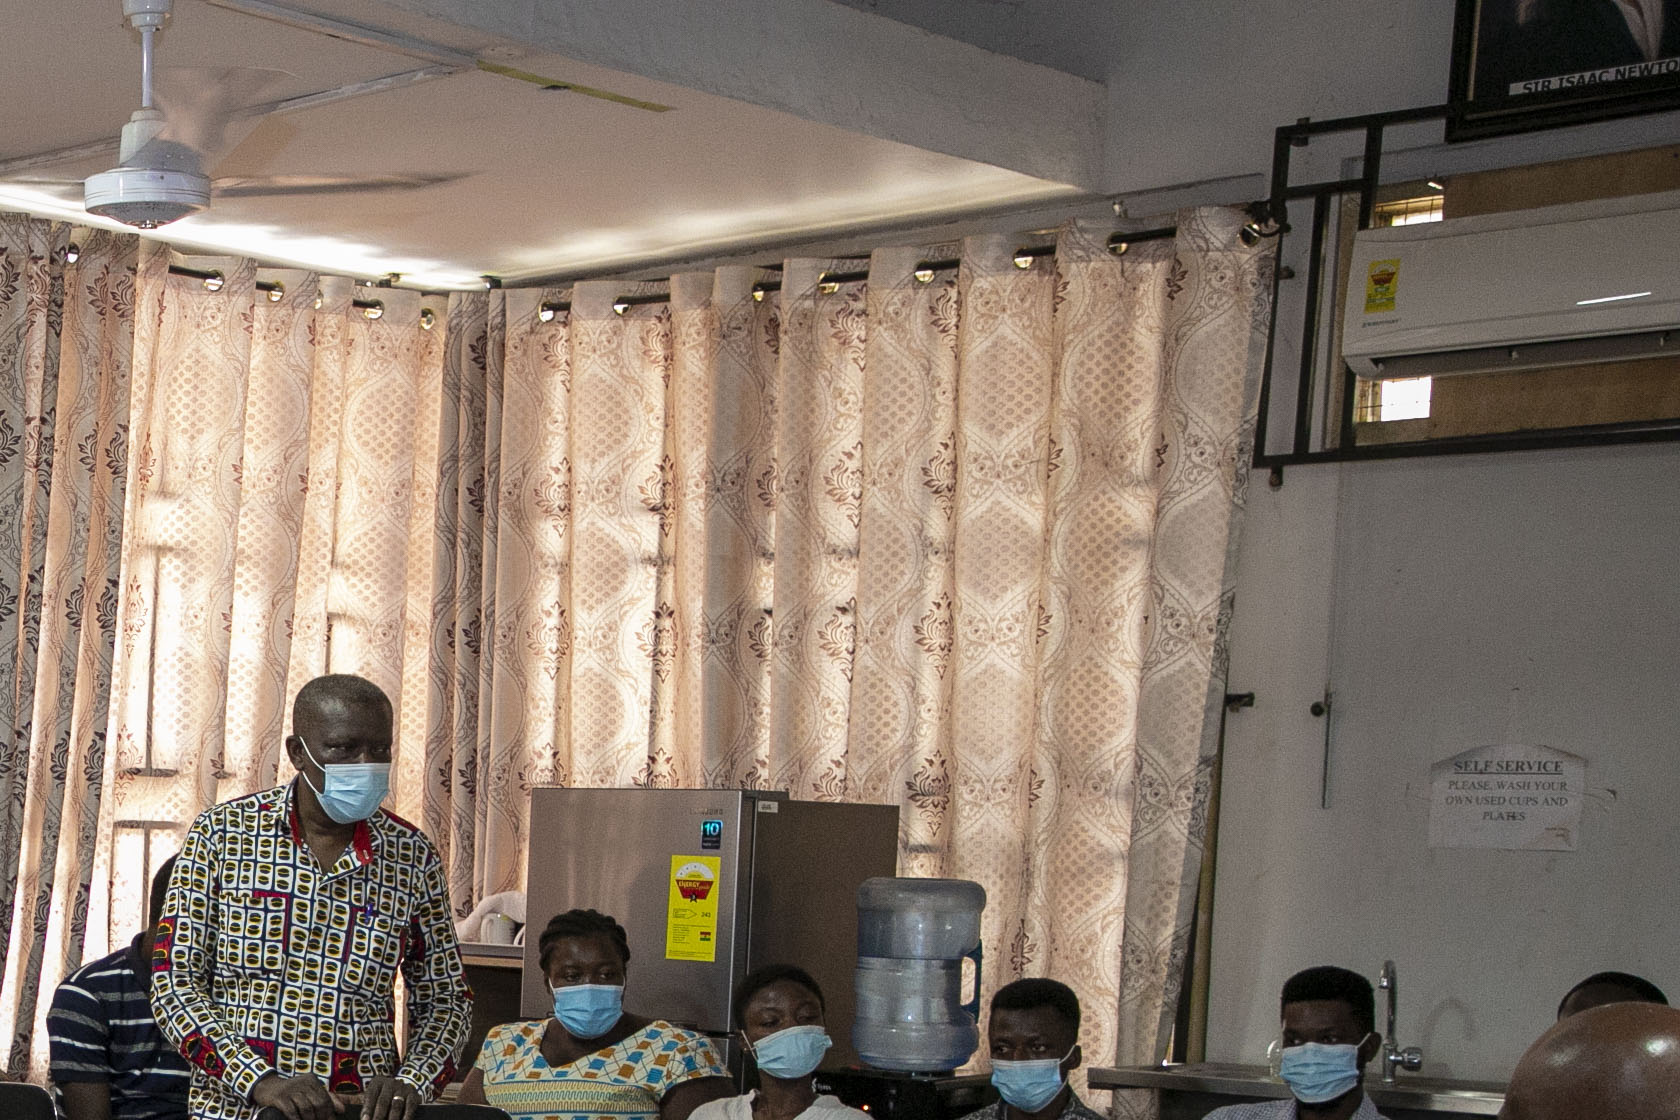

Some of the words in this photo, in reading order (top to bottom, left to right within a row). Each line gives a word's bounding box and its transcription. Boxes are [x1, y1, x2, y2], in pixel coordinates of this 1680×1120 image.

[1523, 80, 1551, 93] SIR
[1559, 70, 1608, 88] ISAAC
[1615, 59, 1679, 81] NEWTO
[1454, 760, 1493, 772] SELF
[1495, 760, 1563, 772] SERVICE
[1496, 780, 1532, 791] WASH
[1533, 780, 1569, 792] YOUR
[1445, 795, 1473, 806] OWN
[1475, 796, 1506, 807] USED
[1508, 796, 1539, 807] CUPS
[1542, 796, 1569, 807] AND
[704, 823, 720, 836] 10
[678, 880, 700, 889] ENERGY
